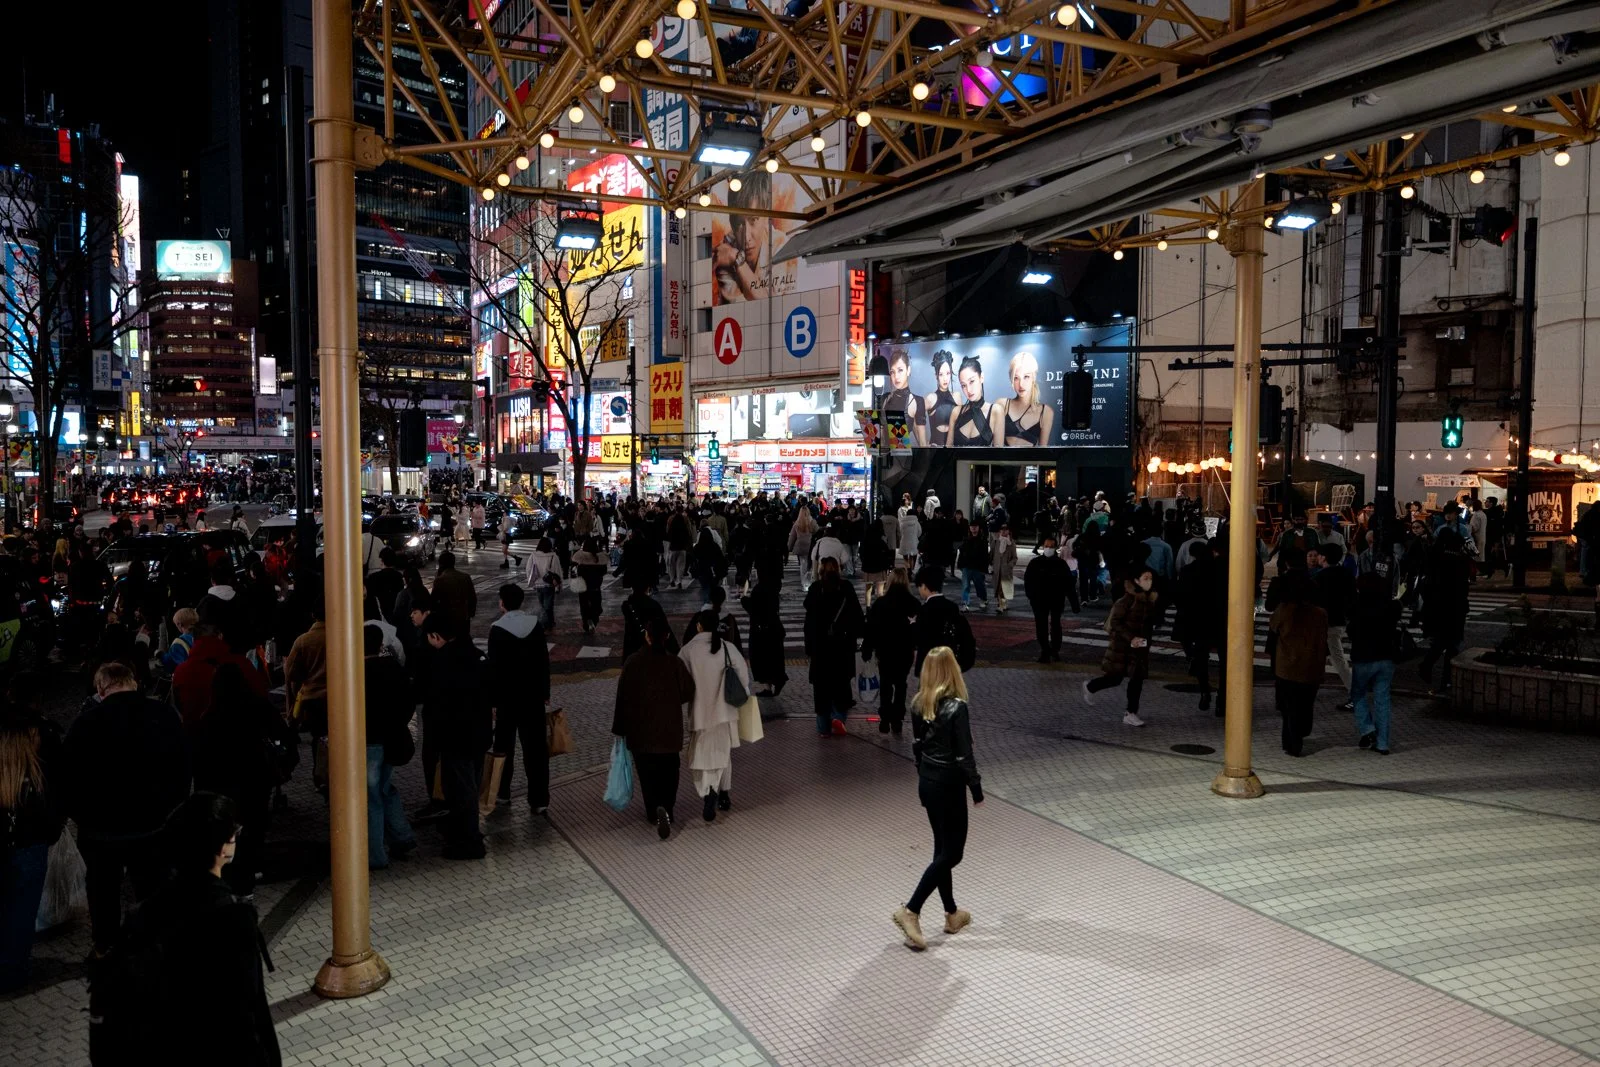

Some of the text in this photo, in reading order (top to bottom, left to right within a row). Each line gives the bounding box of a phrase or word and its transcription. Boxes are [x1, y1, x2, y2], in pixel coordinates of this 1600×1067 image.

[175, 252, 213, 261] TSEI
[670, 280, 679, 339] 処方せん受付
[719, 322, 738, 357] A
[791, 314, 811, 351] B
[524, 356, 532, 378] アコム
[1046, 368, 1120, 381] DEINE
[652, 370, 682, 393] クスリ
[510, 397, 531, 418] LUSH
[652, 397, 682, 421] 調剤
[752, 395, 761, 428] ASUS
[779, 448, 826, 457] ビックカメラ
[1527, 491, 1563, 513] NINJA
[1535, 523, 1554, 532] BEER
